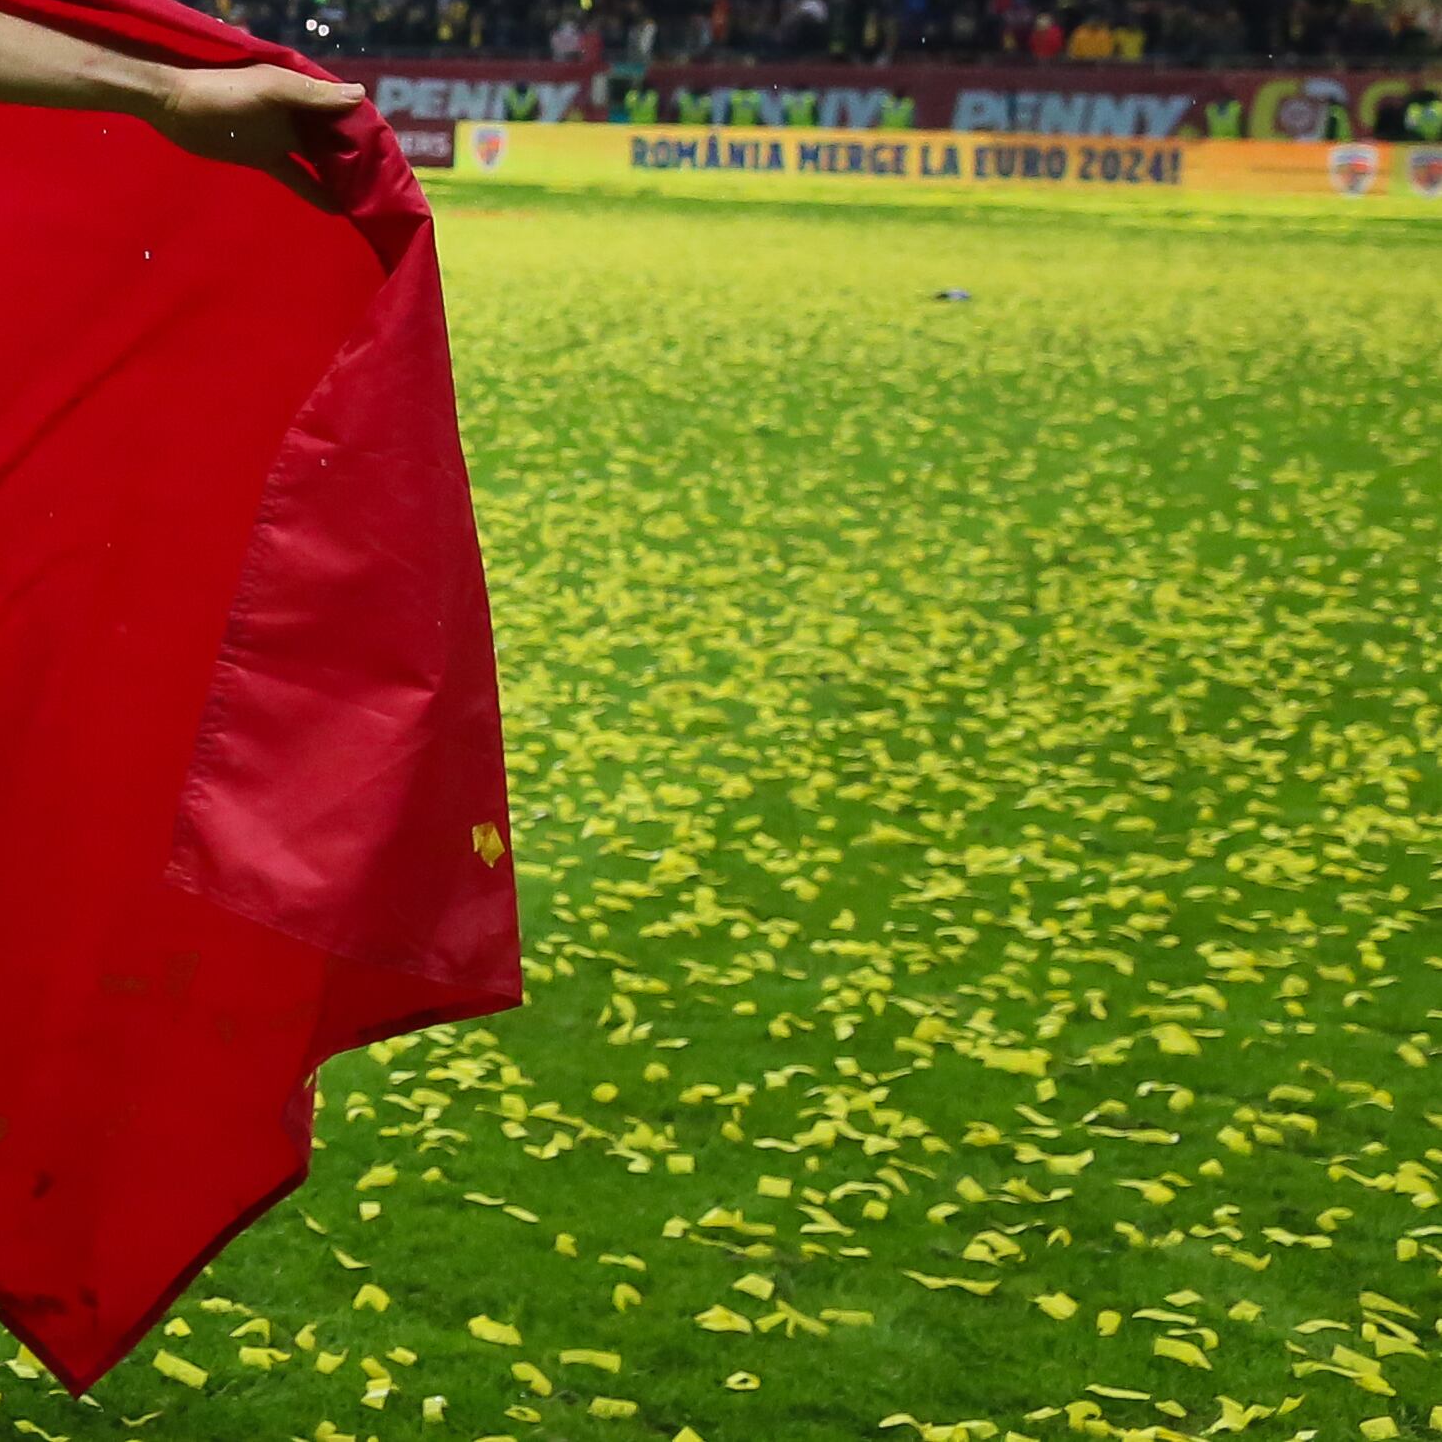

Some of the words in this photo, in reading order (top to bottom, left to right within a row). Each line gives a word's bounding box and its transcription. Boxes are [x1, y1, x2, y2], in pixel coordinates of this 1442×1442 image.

[953, 88, 1191, 138] PENNY
[630, 132, 783, 171] ROMÂNIA
[799, 142, 908, 175] MERGE
[920, 144, 960, 176] LA
[974, 145, 1068, 179] EURO
[1078, 146, 1182, 185] 2024!
